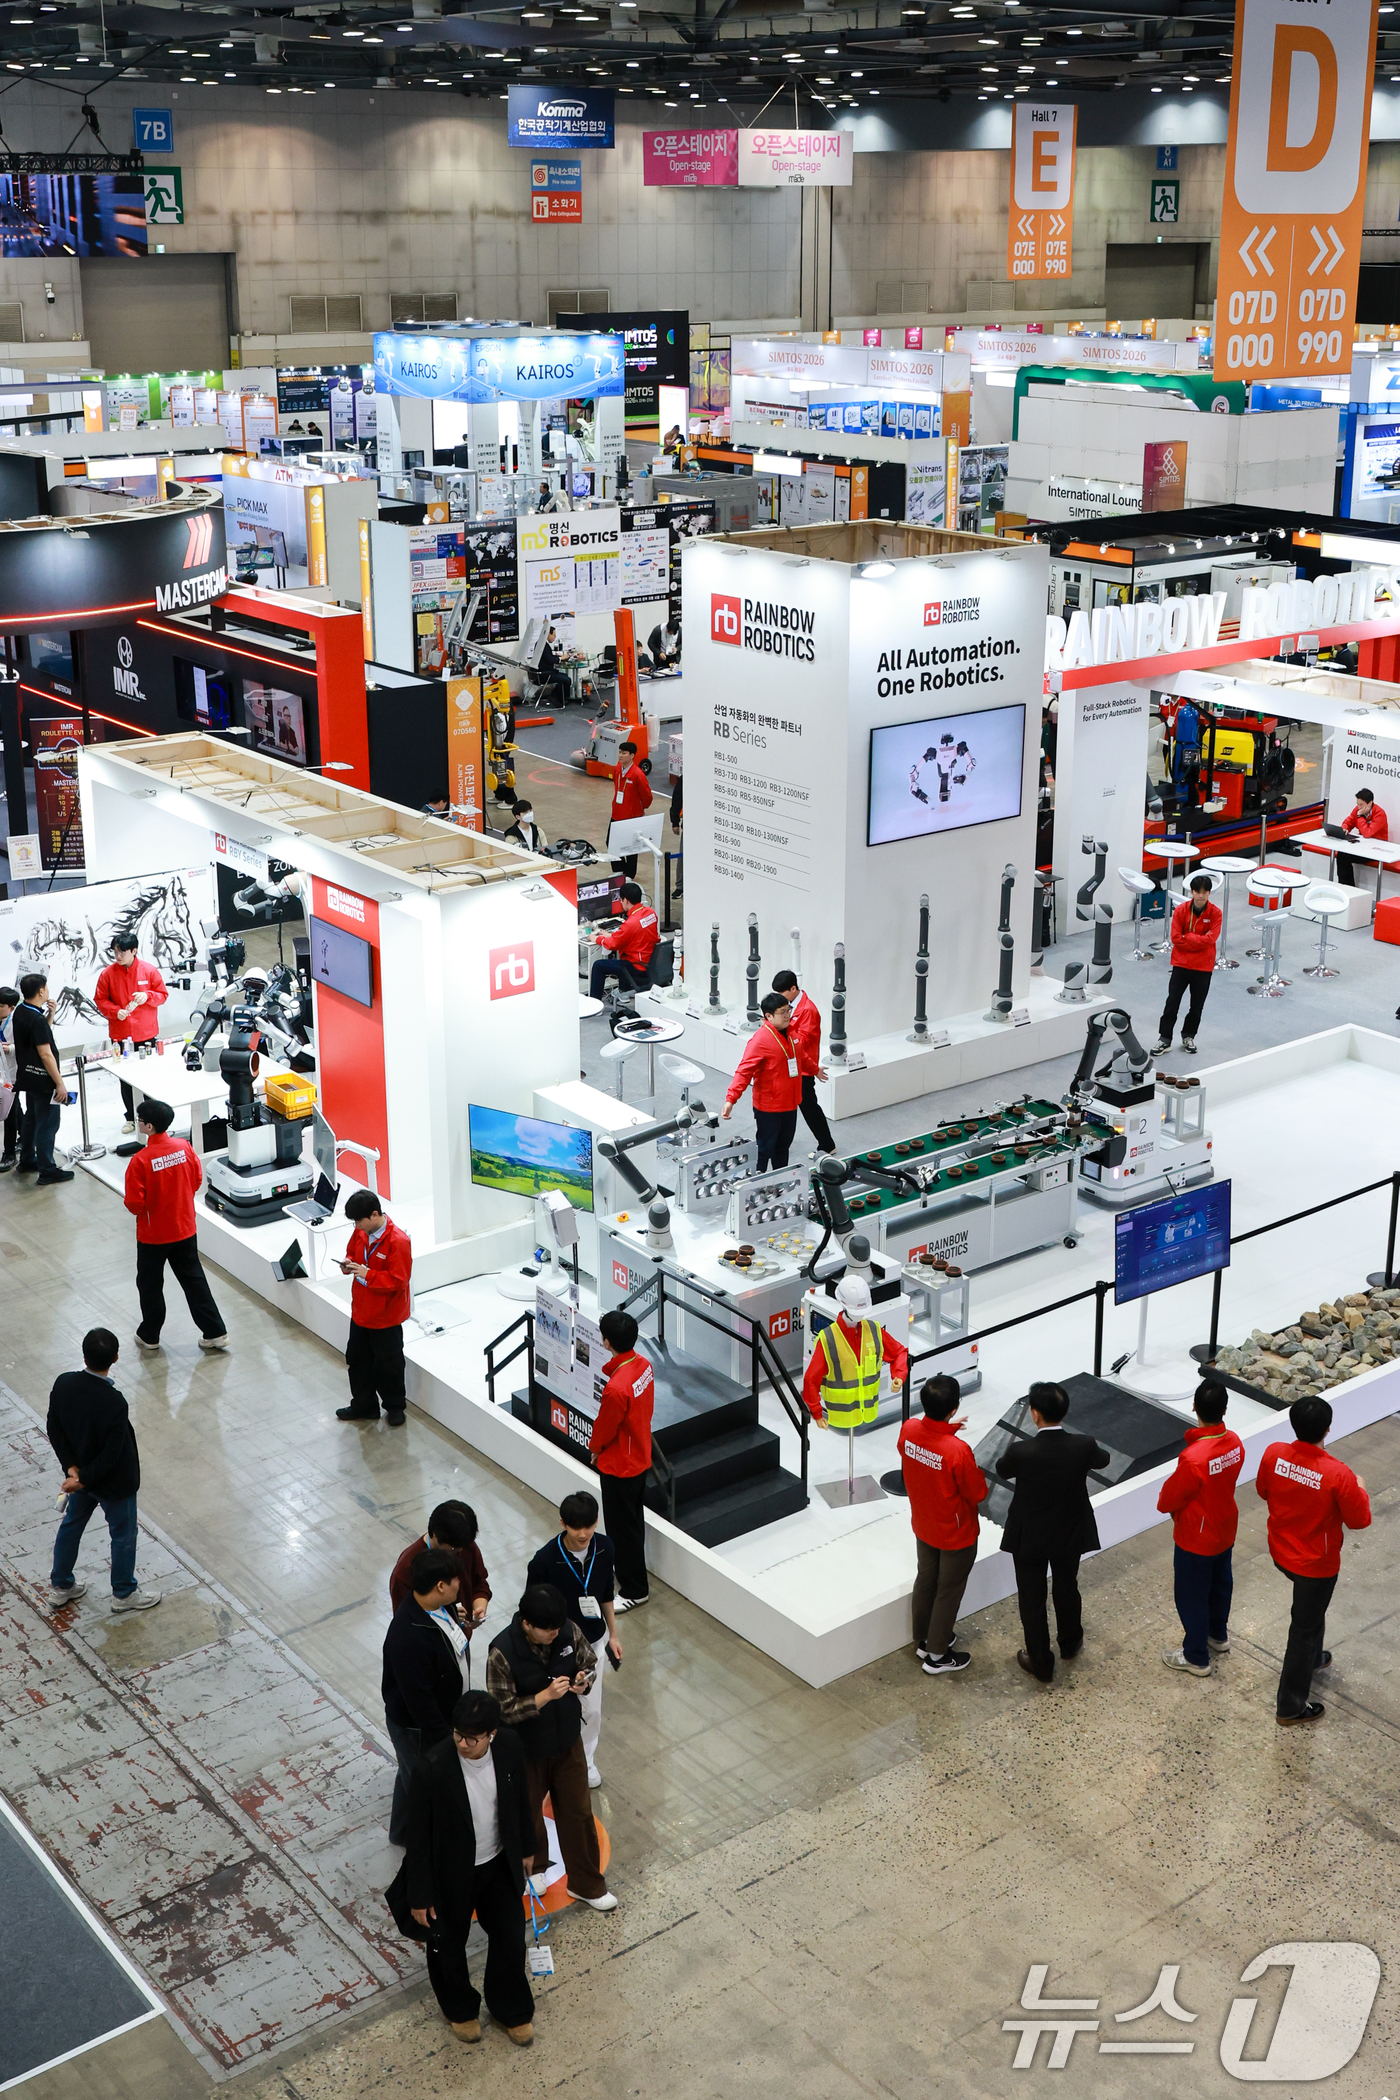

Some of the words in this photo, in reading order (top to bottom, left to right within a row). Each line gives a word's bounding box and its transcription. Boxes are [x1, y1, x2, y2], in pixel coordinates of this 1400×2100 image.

[1266, 23, 1338, 173] D
[537, 101, 587, 118] Komma
[1031, 110, 1048, 122] Hall
[1050, 110, 1058, 122] 7
[140, 120, 167, 141] 7B
[518, 118, 606, 132] 한국공작기계산업협회
[653, 133, 727, 157] 오픈스테이지
[751, 135, 840, 157] 오픈스테이지
[669, 159, 711, 173] Open-stage
[772, 159, 822, 173] Open-stage
[1031, 131, 1059, 192] E
[1163, 157, 1172, 167] A1
[1014, 241, 1035, 257] 07E
[1045, 241, 1067, 256] 07E
[1013, 260, 1035, 275] 000
[1045, 259, 1067, 274] 990
[1228, 291, 1278, 325] 07D
[1298, 288, 1346, 322] 07D
[376, 337, 392, 346] EPSON
[624, 329, 658, 343] IMTOS
[475, 344, 501, 353] EPSON
[978, 340, 1014, 352] SIMTOS
[1014, 342, 1037, 353] 2026
[1082, 347, 1122, 360] SIMTOS
[1122, 349, 1146, 361] 2026
[1227, 333, 1275, 369] 000
[1297, 331, 1342, 364] 990
[768, 351, 803, 365] SIMTOS
[803, 353, 825, 366] 2026
[400, 361, 438, 380] KAIROS
[516, 363, 574, 381] KAIROS
[870, 359, 909, 374] SIMTOS
[909, 364, 934, 376] 2026
[624, 387, 654, 397] IMTOS
[1278, 398, 1294, 406] METAL
[275, 469, 293, 483] ATM
[916, 465, 942, 474] Vitrans
[1158, 475, 1181, 484] SIMTOS
[1048, 484, 1111, 505] International
[1112, 493, 1143, 511] Loung
[1068, 507, 1103, 519] SIMTOS
[550, 521, 570, 534] 명신
[550, 530, 618, 548] ROBOTICS
[155, 566, 227, 613] MASTERCAM
[942, 597, 981, 611] RAINBOW
[744, 598, 815, 635] RAINBOW
[942, 609, 980, 624] ROBOTICS
[1044, 590, 1228, 674] RAINBOW
[1239, 565, 1400, 641] ROBOTICS
[744, 626, 815, 663] ROBOTICS
[877, 650, 902, 673] All
[905, 636, 1021, 668] Automation.
[113, 666, 139, 698] IMR
[877, 673, 915, 698] One
[920, 662, 1005, 692] Robotics.
[1082, 701, 1112, 713] Full-Stack
[1112, 697, 1137, 709] Robotics
[1082, 714, 1092, 722] for
[1092, 710, 1109, 721] Every
[1109, 705, 1142, 718] Automation
[714, 703, 728, 717] 산업
[728, 707, 756, 725] 자동화의
[757, 714, 779, 730] 완벽한
[781, 720, 802, 736] 파트너
[453, 727, 477, 736] 07D560
[713, 720, 730, 739] RB
[732, 725, 767, 749] Series
[1356, 731, 1377, 741] ROBOTICS
[713, 751, 738, 765] RB1-500
[1346, 744, 1360, 755] All
[1361, 747, 1400, 763] Automat
[1345, 758, 1364, 771] One
[1366, 764, 1400, 779] Robotic
[713, 767, 738, 781] RB3-730
[739, 774, 767, 790] RB3-1200
[769, 782, 810, 801] RB3-1200NSF
[713, 783, 738, 798] RB5-850
[739, 791, 775, 808] RB5-850NSF
[713, 800, 741, 815] RB6-1700
[713, 816, 745, 832] RB10-1300
[746, 826, 789, 845] RB10-1300NSF
[713, 832, 741, 848] RB16-900
[229, 846, 241, 859] RBY
[242, 852, 262, 869] Series
[713, 848, 745, 865] RB20-1800
[746, 858, 777, 876] RB20-1900
[273, 861, 297, 873] ZON
[713, 864, 745, 881] RB30-1400
[339, 890, 365, 912] RAINBOW
[339, 901, 366, 923] ROBOTICS
[495, 953, 530, 991] rb
[1139, 1118, 1147, 1135] 2
[1137, 1141, 1154, 1151] RAINBOW
[1137, 1146, 1154, 1156] ROBOTICS
[163, 1149, 186, 1161] RAINBOW
[164, 1156, 187, 1168] ROBOTICS
[928, 1230, 969, 1252] RAINBOW
[933, 1242, 969, 1262] OBOTICS
[772, 1316, 788, 1335] rb
[568, 1410, 593, 1435] RAINB
[568, 1425, 591, 1450] ROBO
[915, 1453, 942, 1471] ROBOTICS
[916, 1446, 943, 1463] RAINBOW
[1221, 1446, 1241, 1462] RAINBOW
[1221, 1454, 1241, 1470] ROBOTICS
[1290, 1463, 1323, 1480] RAINBOW
[1289, 1471, 1321, 1490] ROBOTICS
